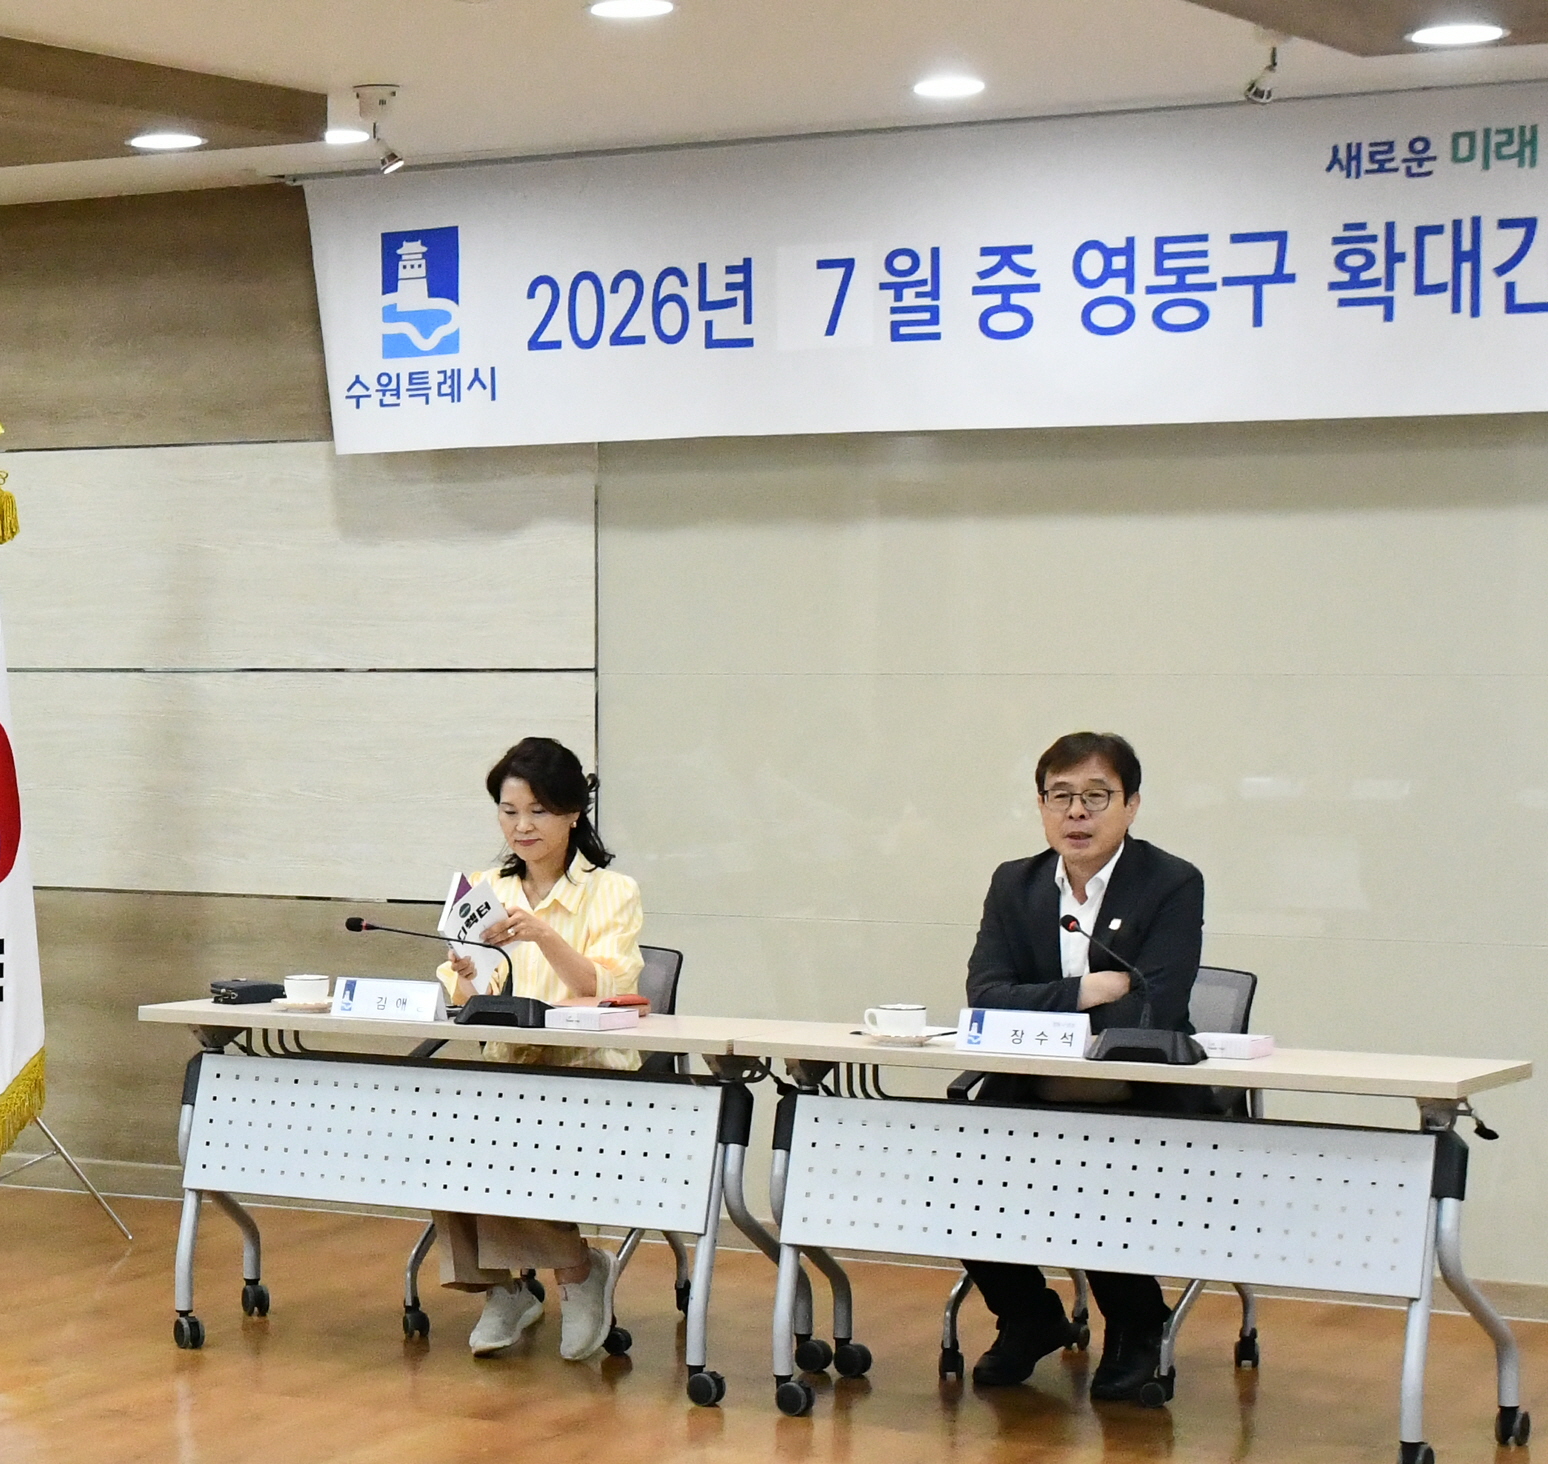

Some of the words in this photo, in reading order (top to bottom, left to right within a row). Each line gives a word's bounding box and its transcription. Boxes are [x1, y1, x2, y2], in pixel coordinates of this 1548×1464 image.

[1324, 135, 1438, 180] 새로운
[1449, 123, 1539, 171] 미래
[526, 257, 755, 351] 2026년
[971, 243, 1042, 341] 중
[1070, 229, 1298, 338] 영통구
[344, 365, 497, 410] 수원특례시
